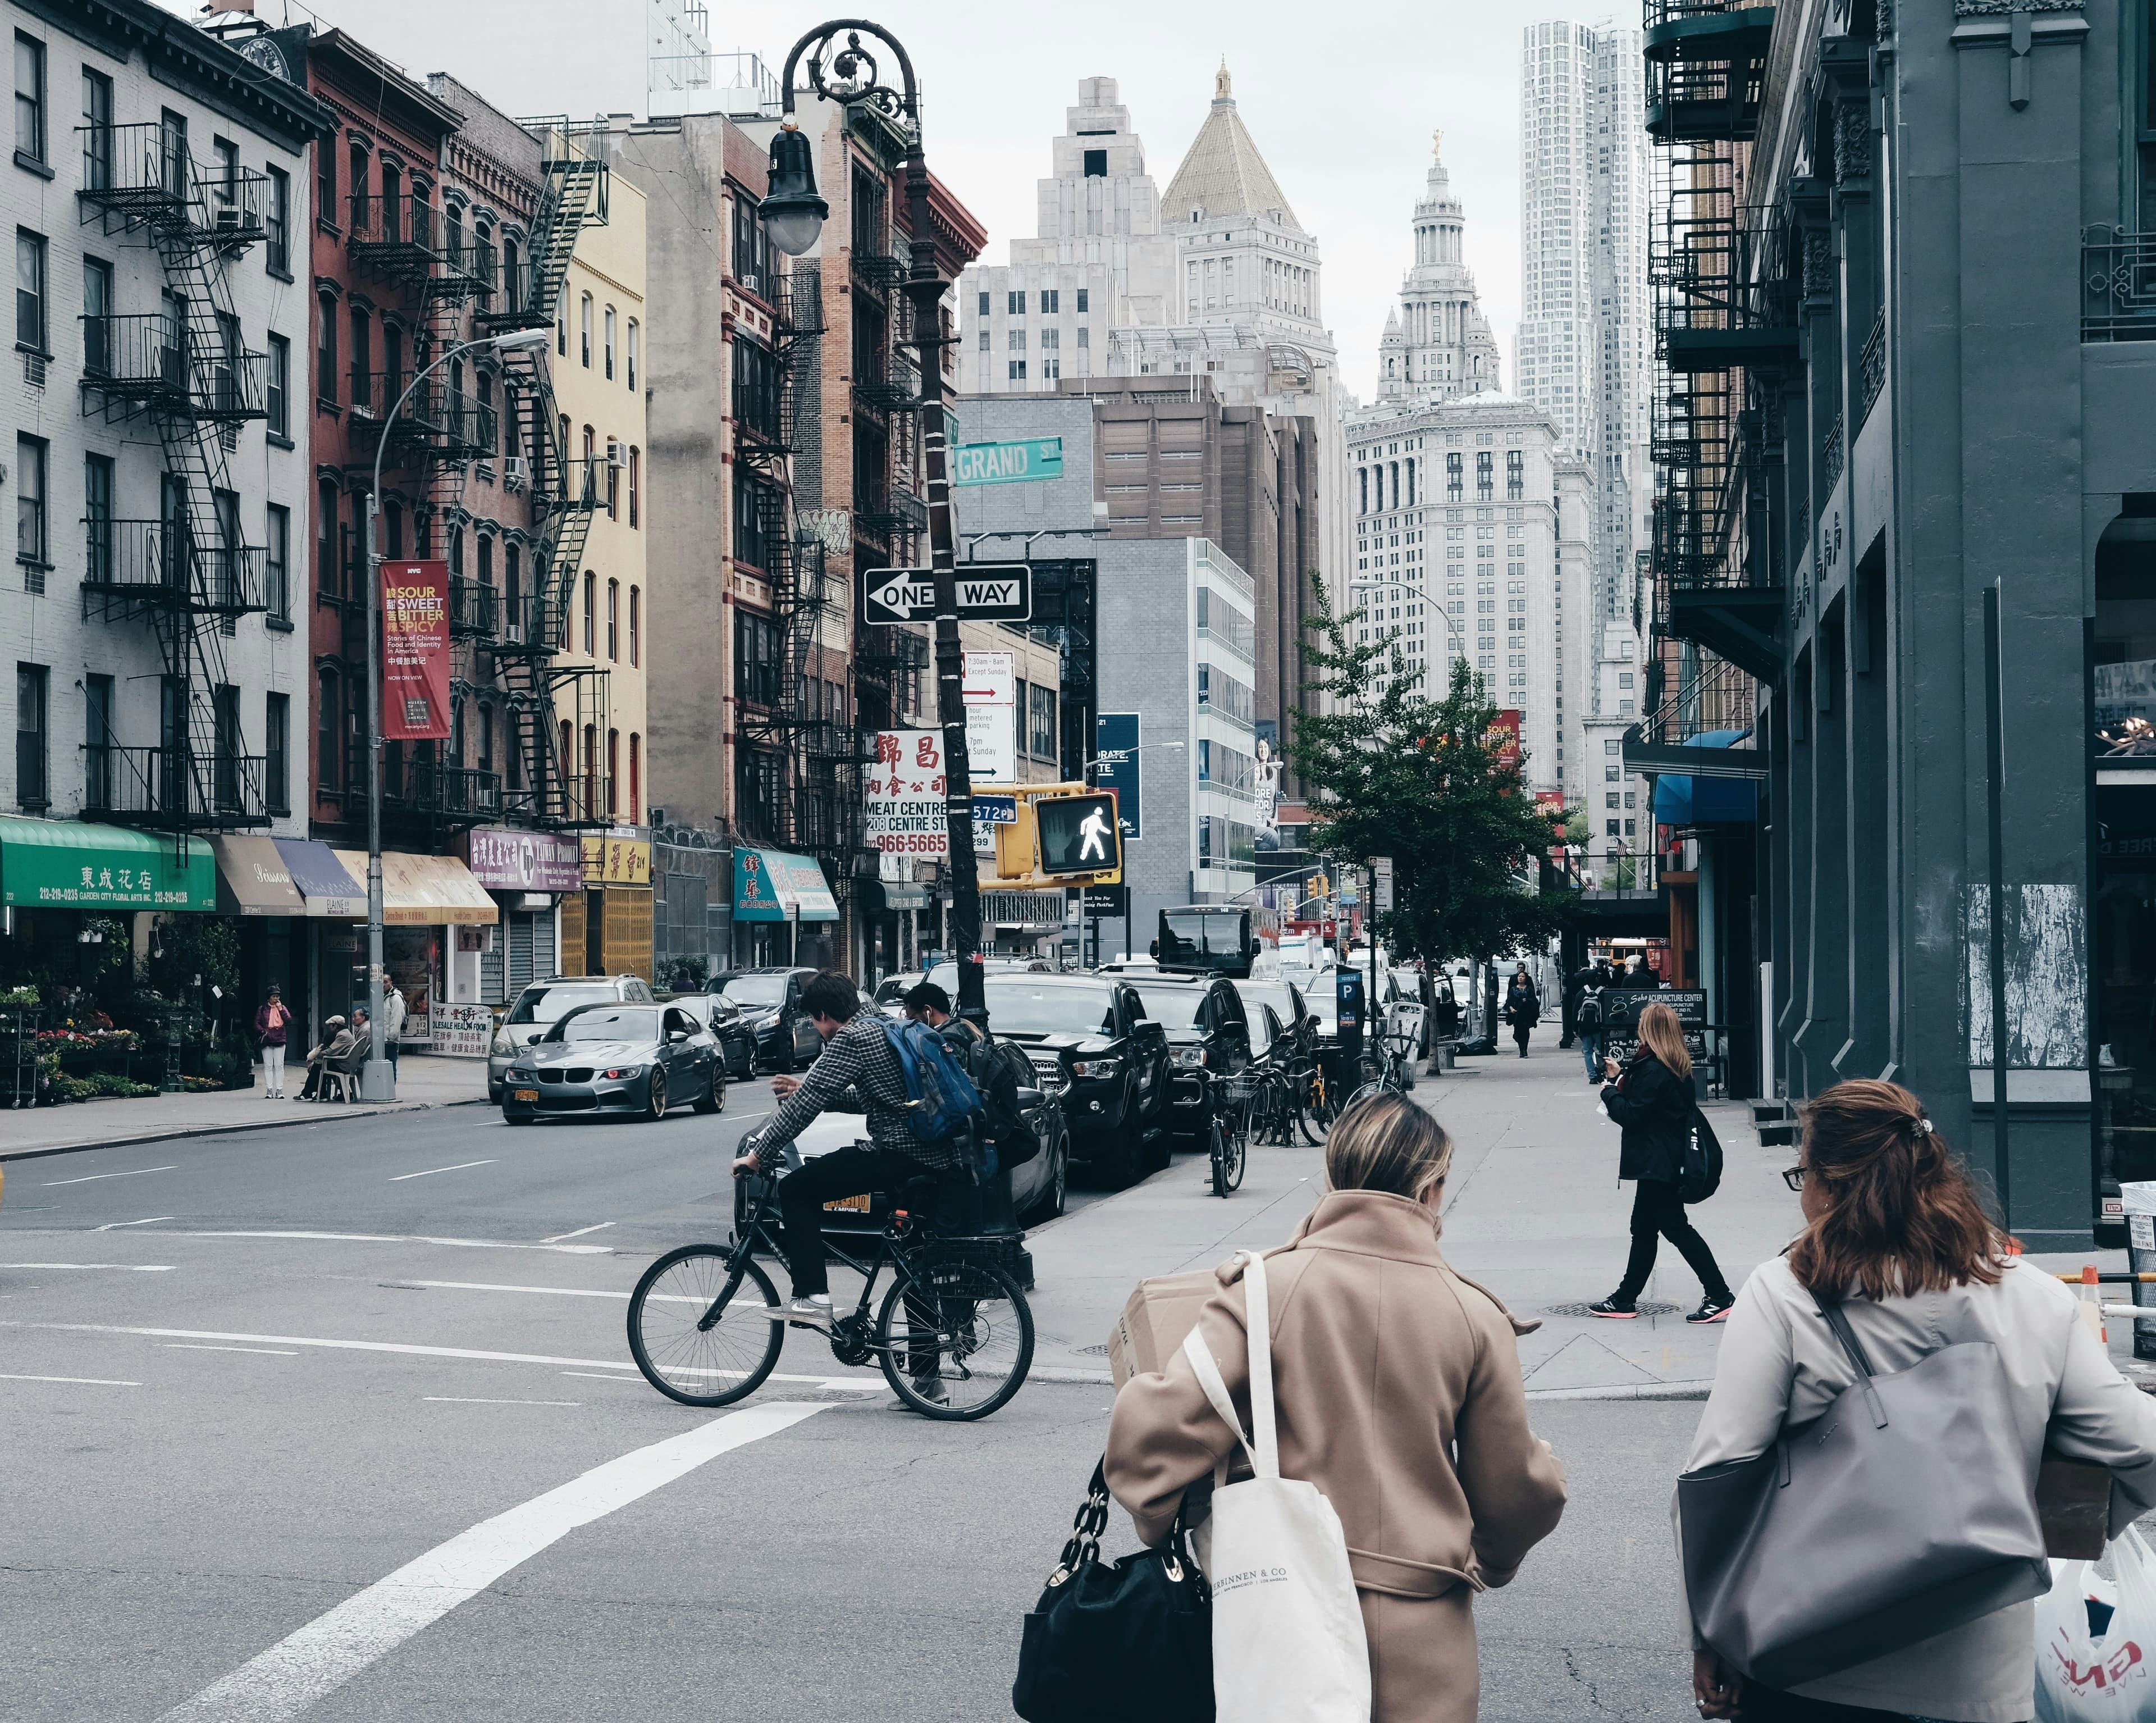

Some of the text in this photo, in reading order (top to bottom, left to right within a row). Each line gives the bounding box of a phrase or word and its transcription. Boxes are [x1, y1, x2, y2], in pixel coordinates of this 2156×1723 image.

[958, 443, 1057, 480] GRAND ST
[398, 586, 435, 599] SOUR
[884, 584, 1014, 606] ONE WAY
[398, 598, 443, 610] SWEET
[387, 609, 444, 621] 苦 BITTER
[399, 621, 436, 632] SPICY
[970, 737, 983, 746] 7pm
[973, 747, 996, 756] Sunday
[866, 802, 947, 815] MEAT CENTRE
[1254, 800, 1269, 810] FOR
[974, 805, 1001, 819] 572
[867, 817, 946, 831] 208 CENTRE ST.
[536, 841, 555, 862] TAIWAN
[80, 866, 152, 890] 東成花店
[254, 863, 290, 883] Scissors
[40, 887, 78, 901] 212-219-0235
[79, 892, 100, 900] GARDEN
[113, 893, 130, 901] FLORAL
[155, 891, 188, 903] 212-219-0235
[327, 899, 344, 910] ELAINE
[739, 900, 778, 909] 彩色印刷公司
[1343, 984, 1352, 998] P
[1630, 994, 1648, 1004] Soho
[1648, 994, 1683, 1002] ACUPUNCTURE
[1212, 1570, 1257, 1591] ERBINNEN
[1231, 1580, 1253, 1590] FRANCISCO
